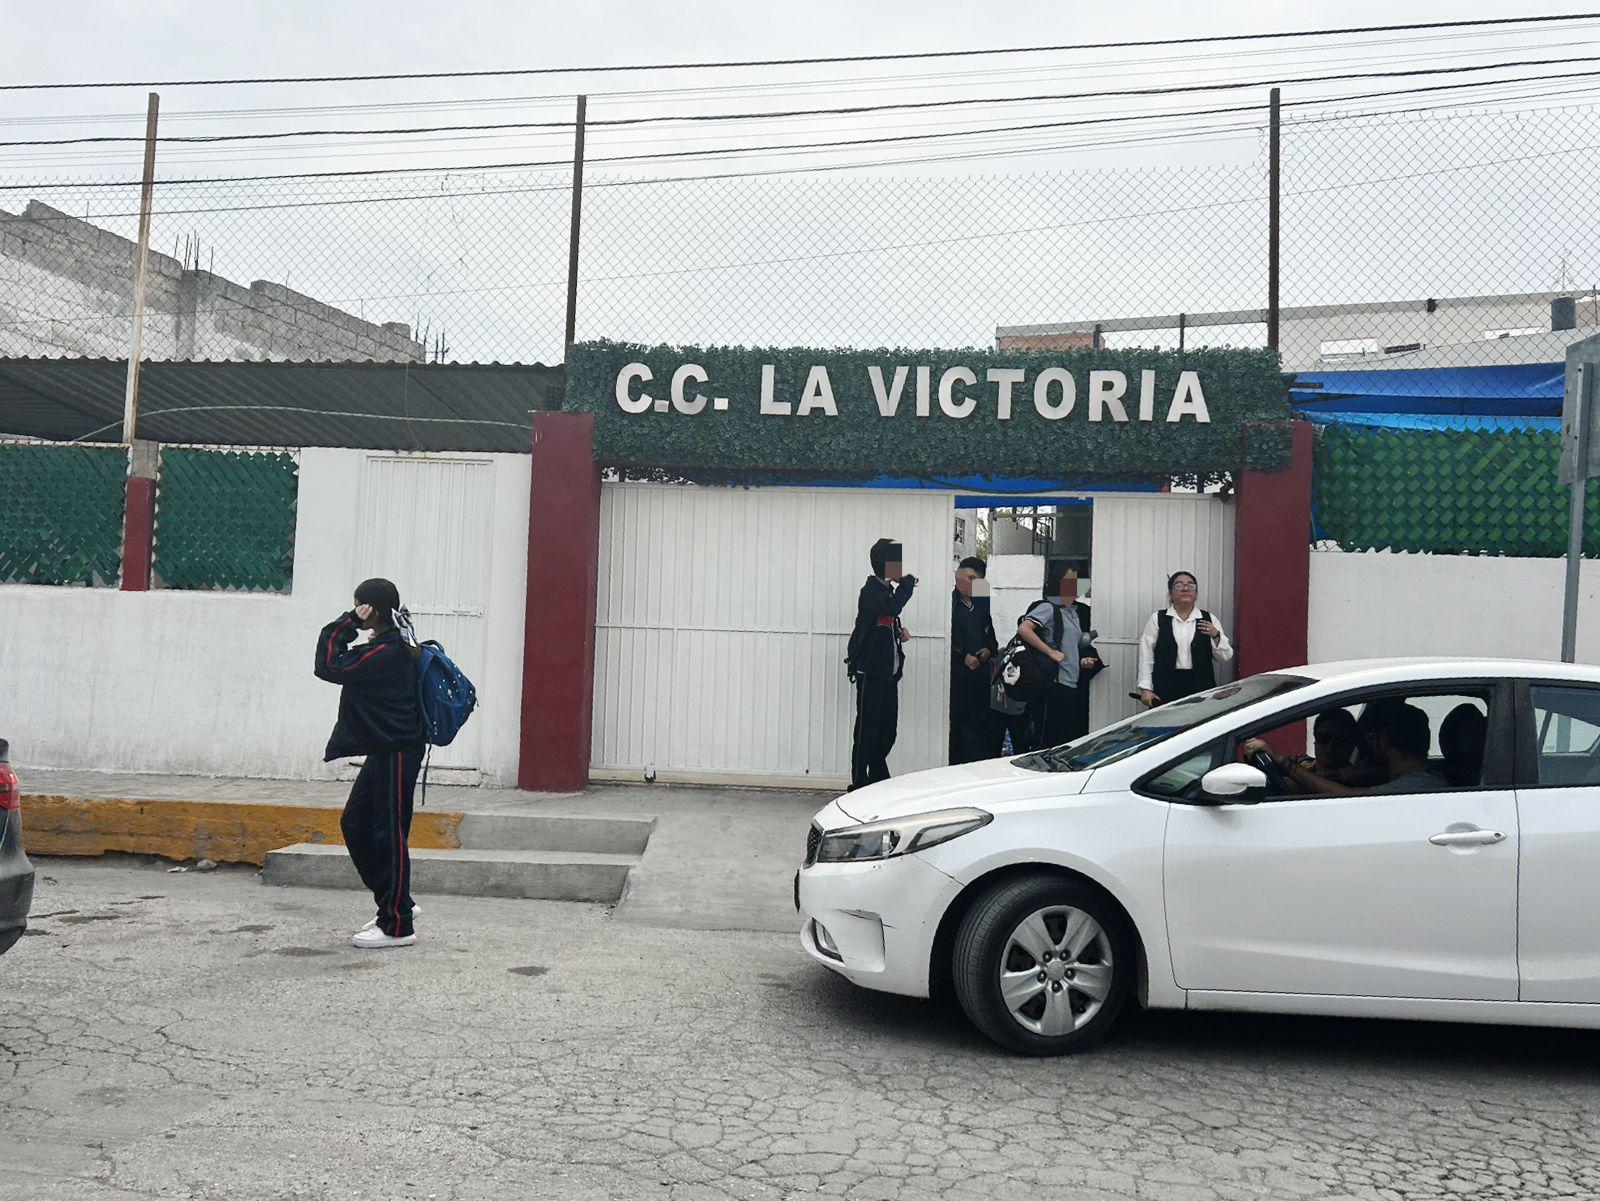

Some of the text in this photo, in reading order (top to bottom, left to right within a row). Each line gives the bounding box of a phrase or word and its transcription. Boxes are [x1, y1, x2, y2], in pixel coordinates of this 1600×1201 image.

[615, 362, 1211, 423] C.C. LA VICTORIA
